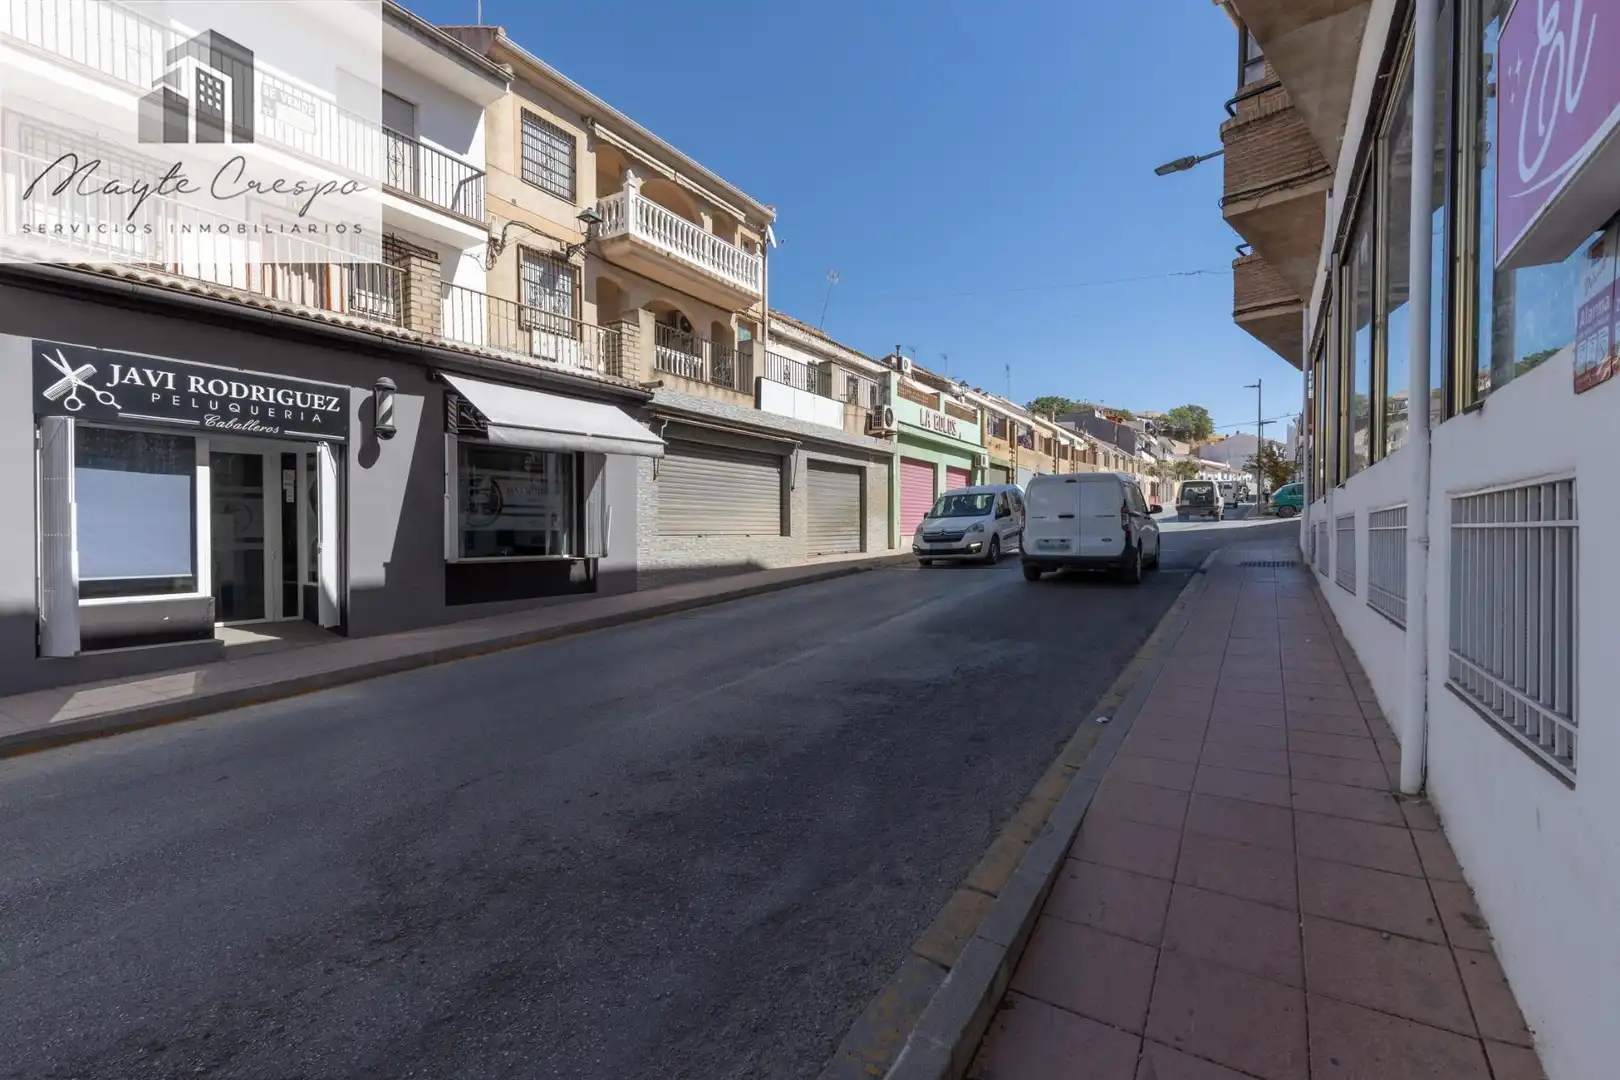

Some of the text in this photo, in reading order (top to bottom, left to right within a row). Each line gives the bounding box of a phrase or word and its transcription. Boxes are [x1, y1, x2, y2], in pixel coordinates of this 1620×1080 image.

[263, 84, 315, 116] SE VENDE
[1579, 295, 1610, 329] Alarma
[106, 363, 341, 412] JAVI RODRIGUEZ
[151, 392, 322, 423] PELUQUERIA
[920, 408, 931, 428] LA
[204, 413, 280, 434] Caballeros
